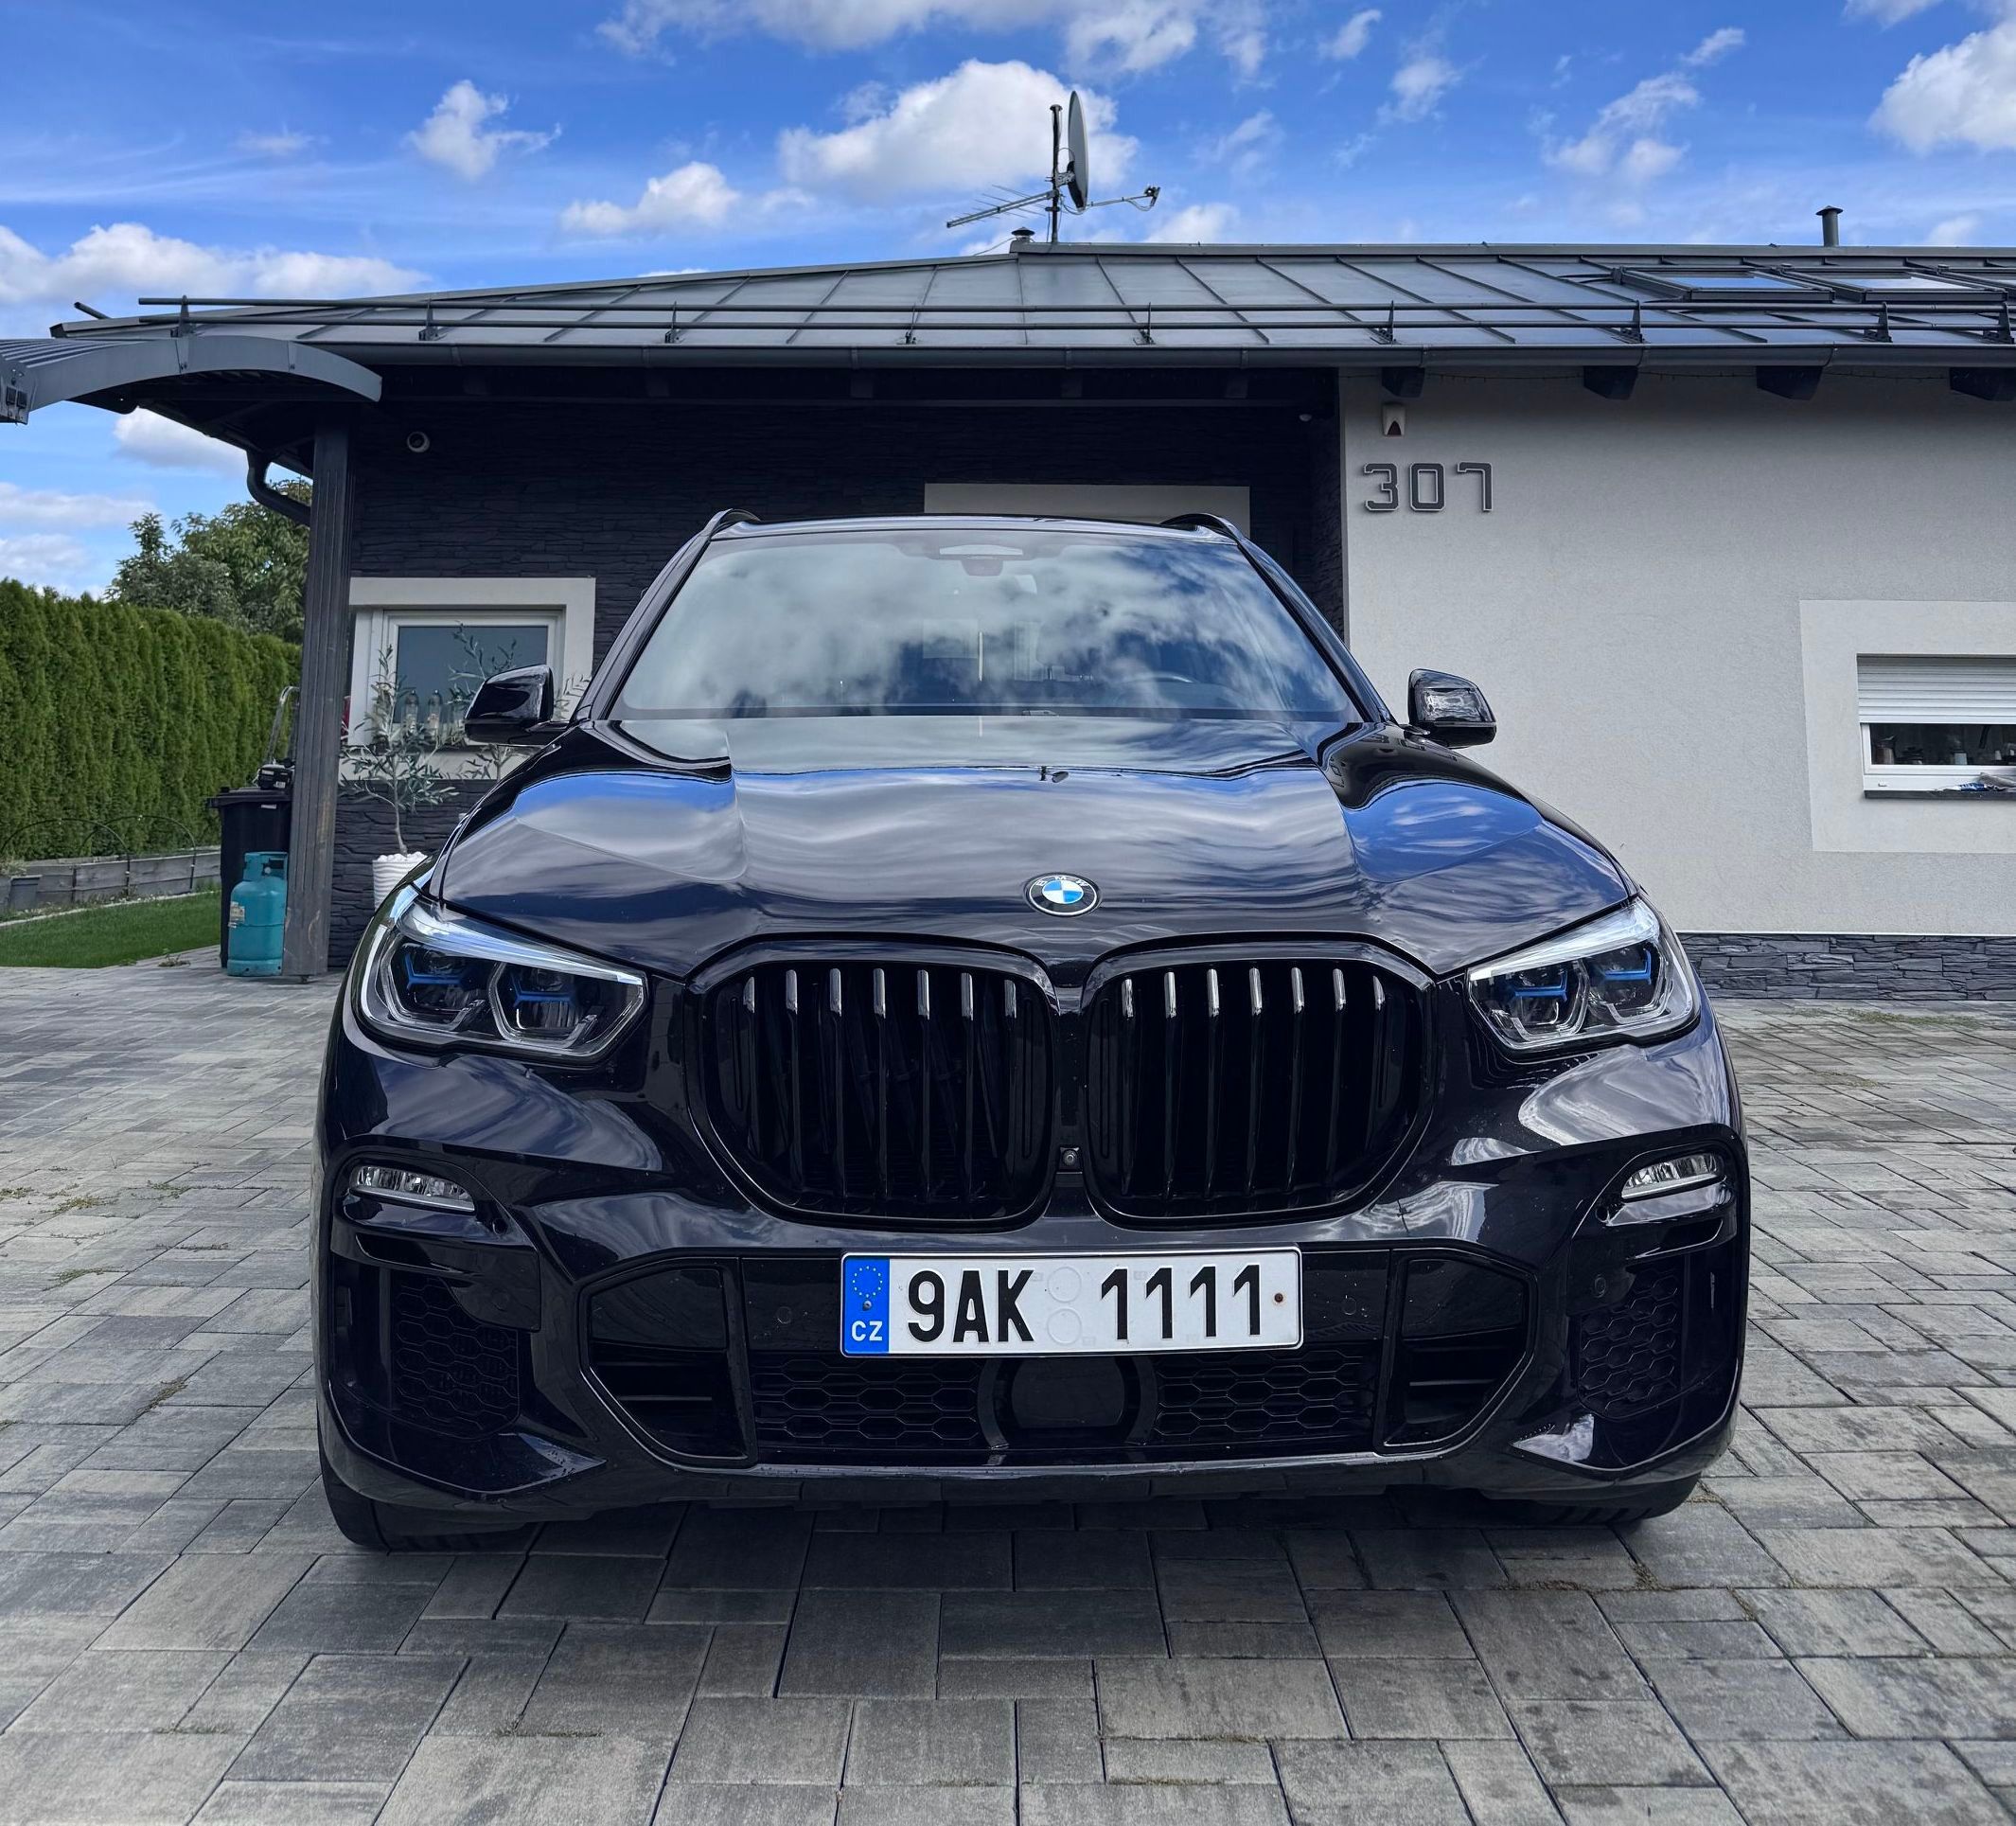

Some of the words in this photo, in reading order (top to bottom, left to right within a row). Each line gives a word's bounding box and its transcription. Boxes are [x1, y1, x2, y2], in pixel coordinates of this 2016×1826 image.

[1364, 462, 1493, 512] 307
[908, 1269, 1035, 1343] 9AK
[1101, 1265, 1261, 1340] 1111
[851, 1320, 883, 1342] CZ
